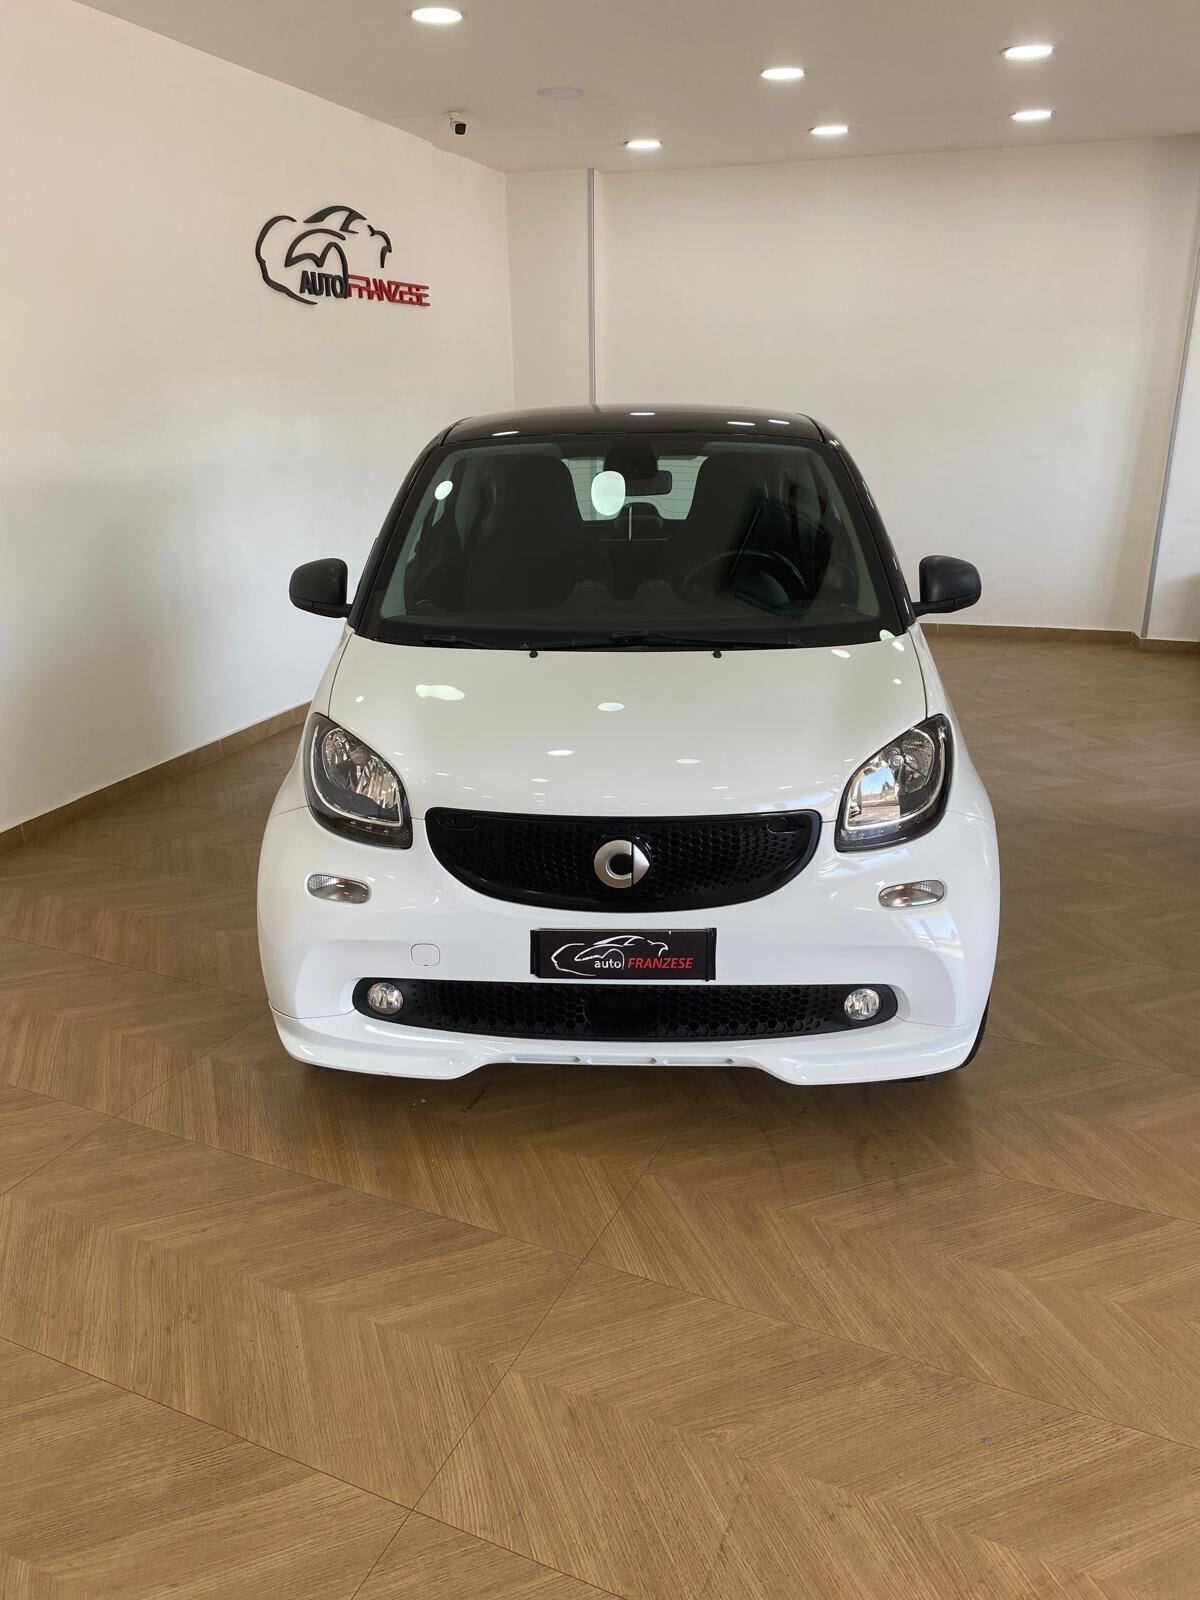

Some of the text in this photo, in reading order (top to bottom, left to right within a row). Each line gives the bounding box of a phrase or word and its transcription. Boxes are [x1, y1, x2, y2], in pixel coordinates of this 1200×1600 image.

[299, 270, 430, 306] AUTO FRANZESE
[594, 957, 694, 969] auto FRANZESE
